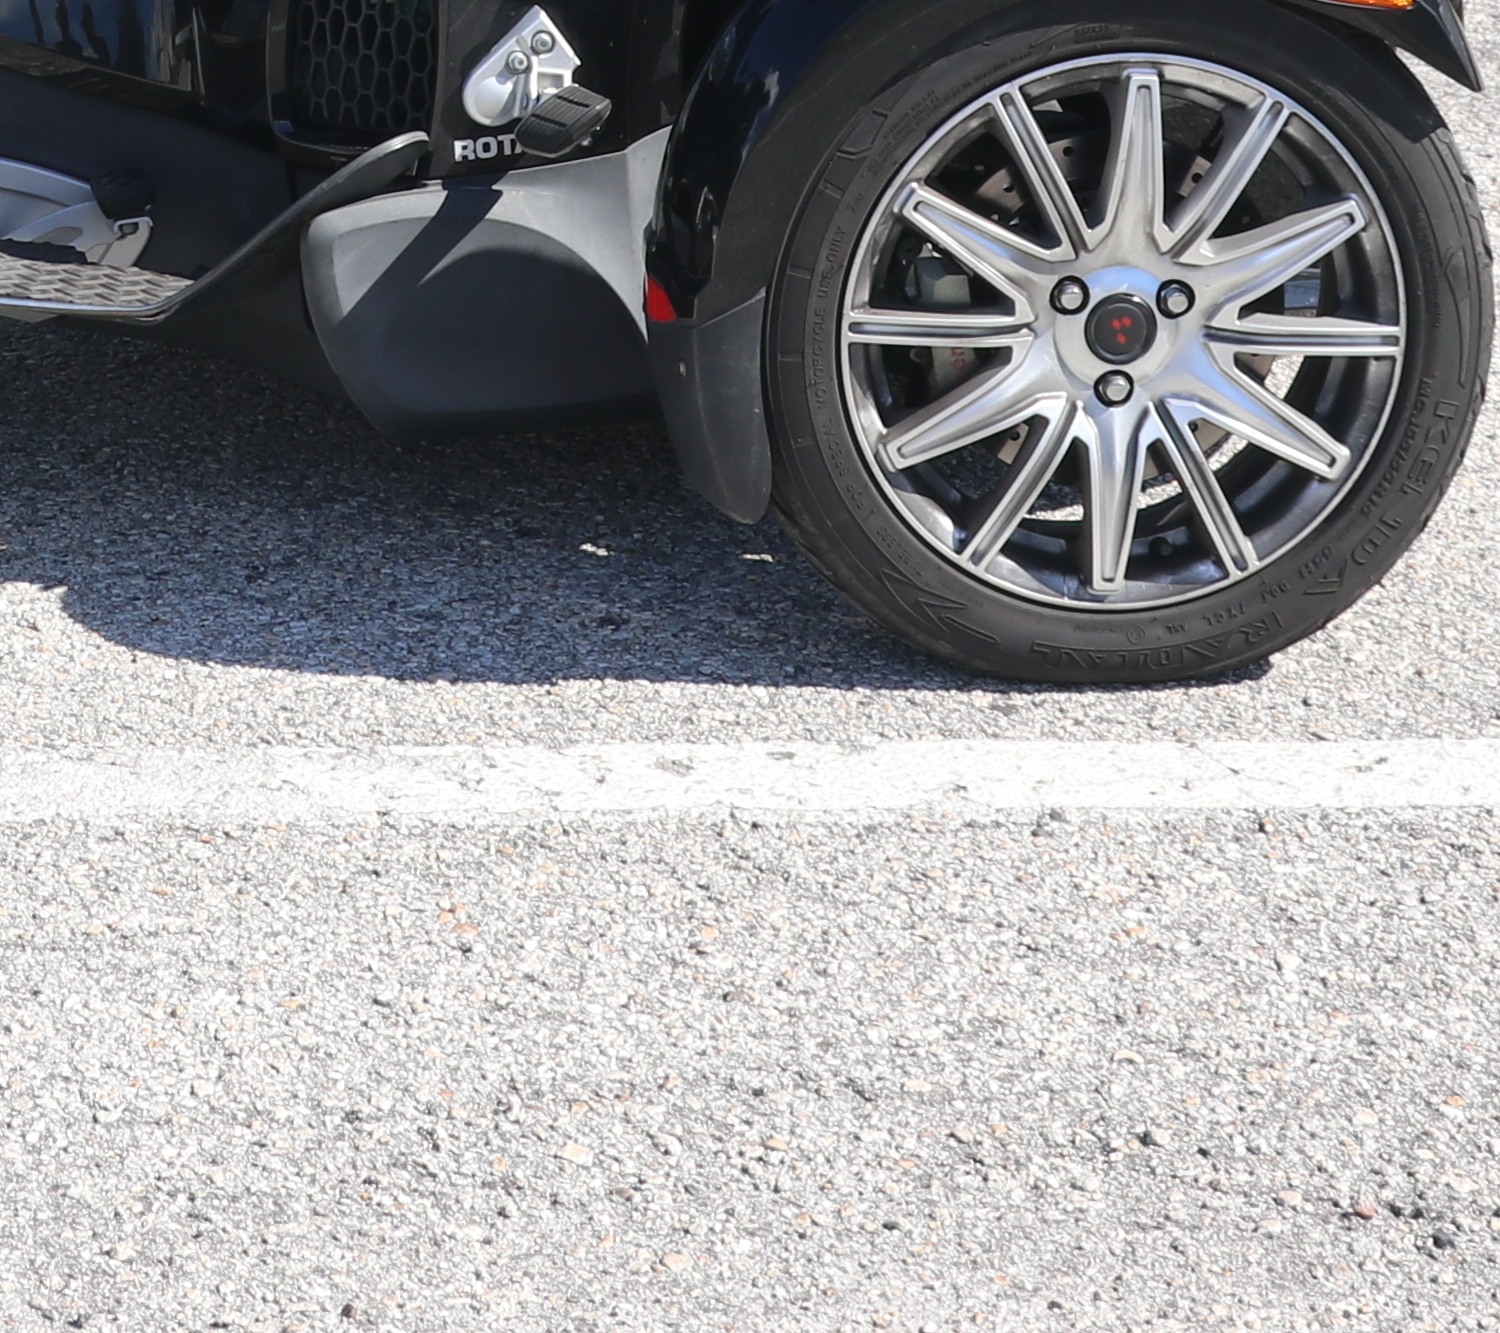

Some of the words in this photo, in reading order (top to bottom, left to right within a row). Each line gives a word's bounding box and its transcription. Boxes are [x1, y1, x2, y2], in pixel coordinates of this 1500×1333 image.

[453, 133, 523, 162] ROT
[812, 306, 830, 410] MOTORCYCLE
[824, 223, 848, 264] ONLY
[1300, 397, 1460, 611] KENDA
[873, 522, 928, 578] TUBELESS
[1026, 609, 1285, 673] RADIAL
